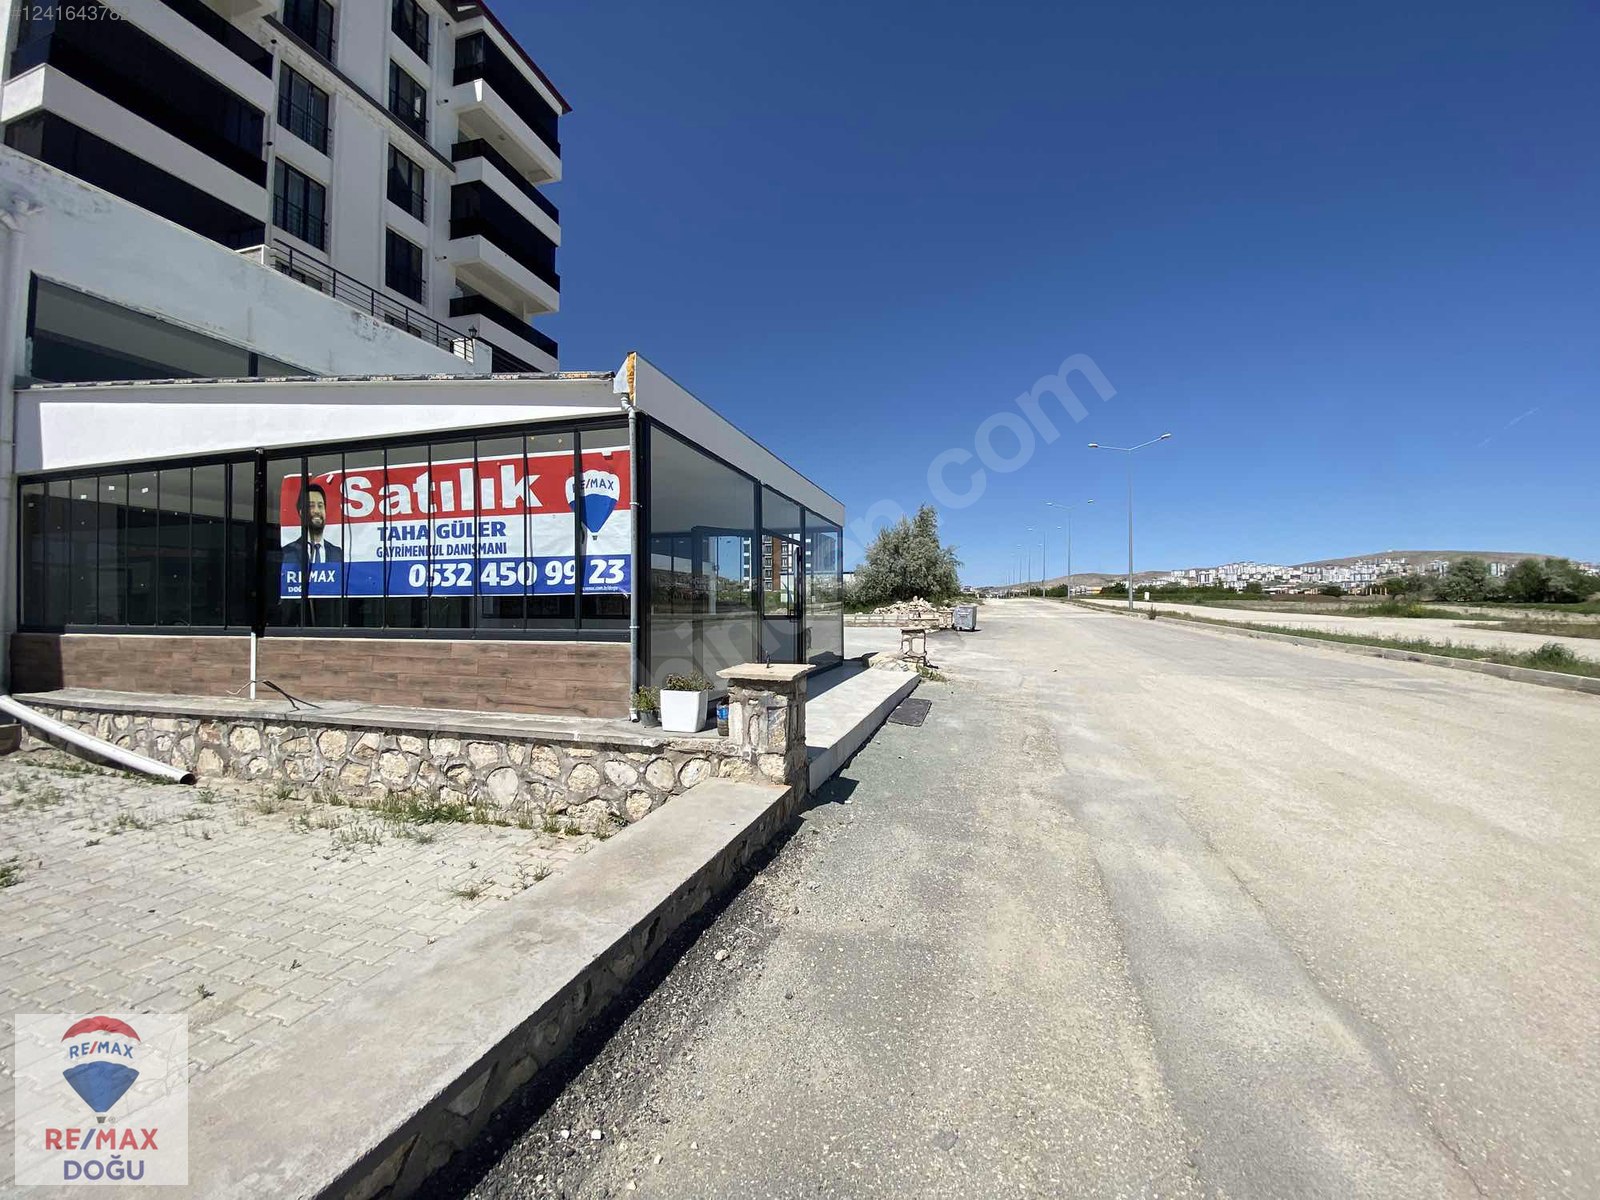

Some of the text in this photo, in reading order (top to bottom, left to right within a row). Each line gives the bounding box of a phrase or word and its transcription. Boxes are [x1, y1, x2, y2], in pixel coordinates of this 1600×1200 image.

[340, 464, 543, 518] Satılık
[572, 478, 614, 493] E/MAX
[377, 520, 507, 541] TAHA GÜLER
[286, 570, 336, 583] RMAX
[409, 559, 625, 588] 0532 450 99 23
